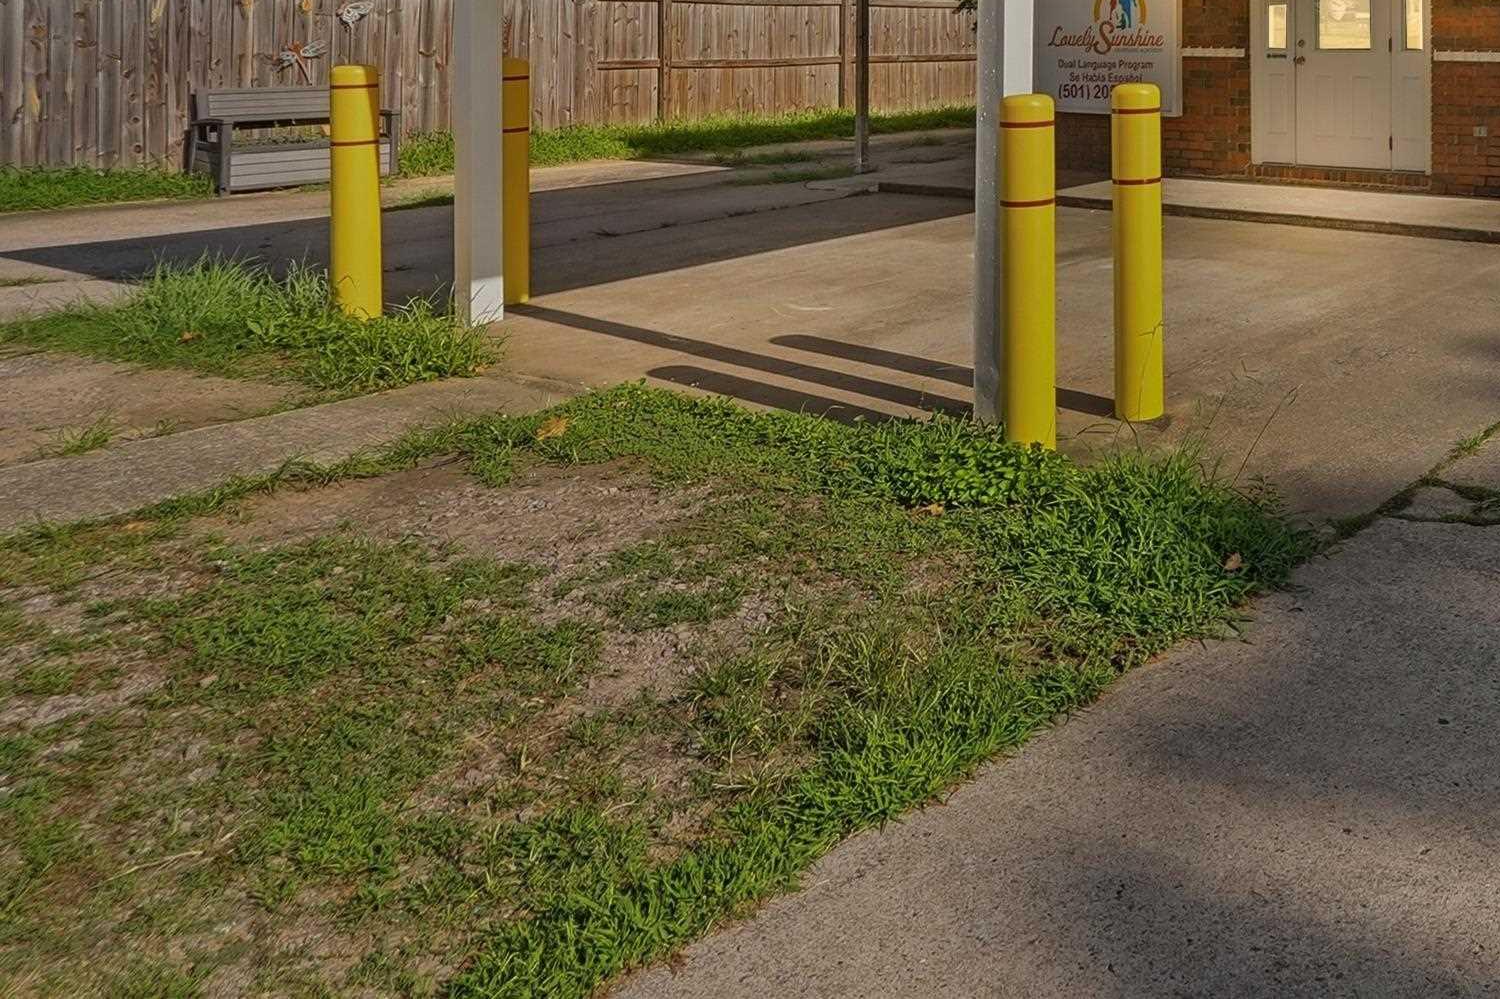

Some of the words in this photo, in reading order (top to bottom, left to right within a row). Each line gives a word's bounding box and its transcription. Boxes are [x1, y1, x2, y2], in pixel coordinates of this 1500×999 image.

[1048, 25, 1095, 52] Lovely
[1093, 20, 1164, 55] Sunshine
[1058, 59, 1076, 69] Dual
[1078, 60, 1117, 71] Language
[1119, 60, 1154, 71] Program
[1058, 84, 1090, 100] (501)
